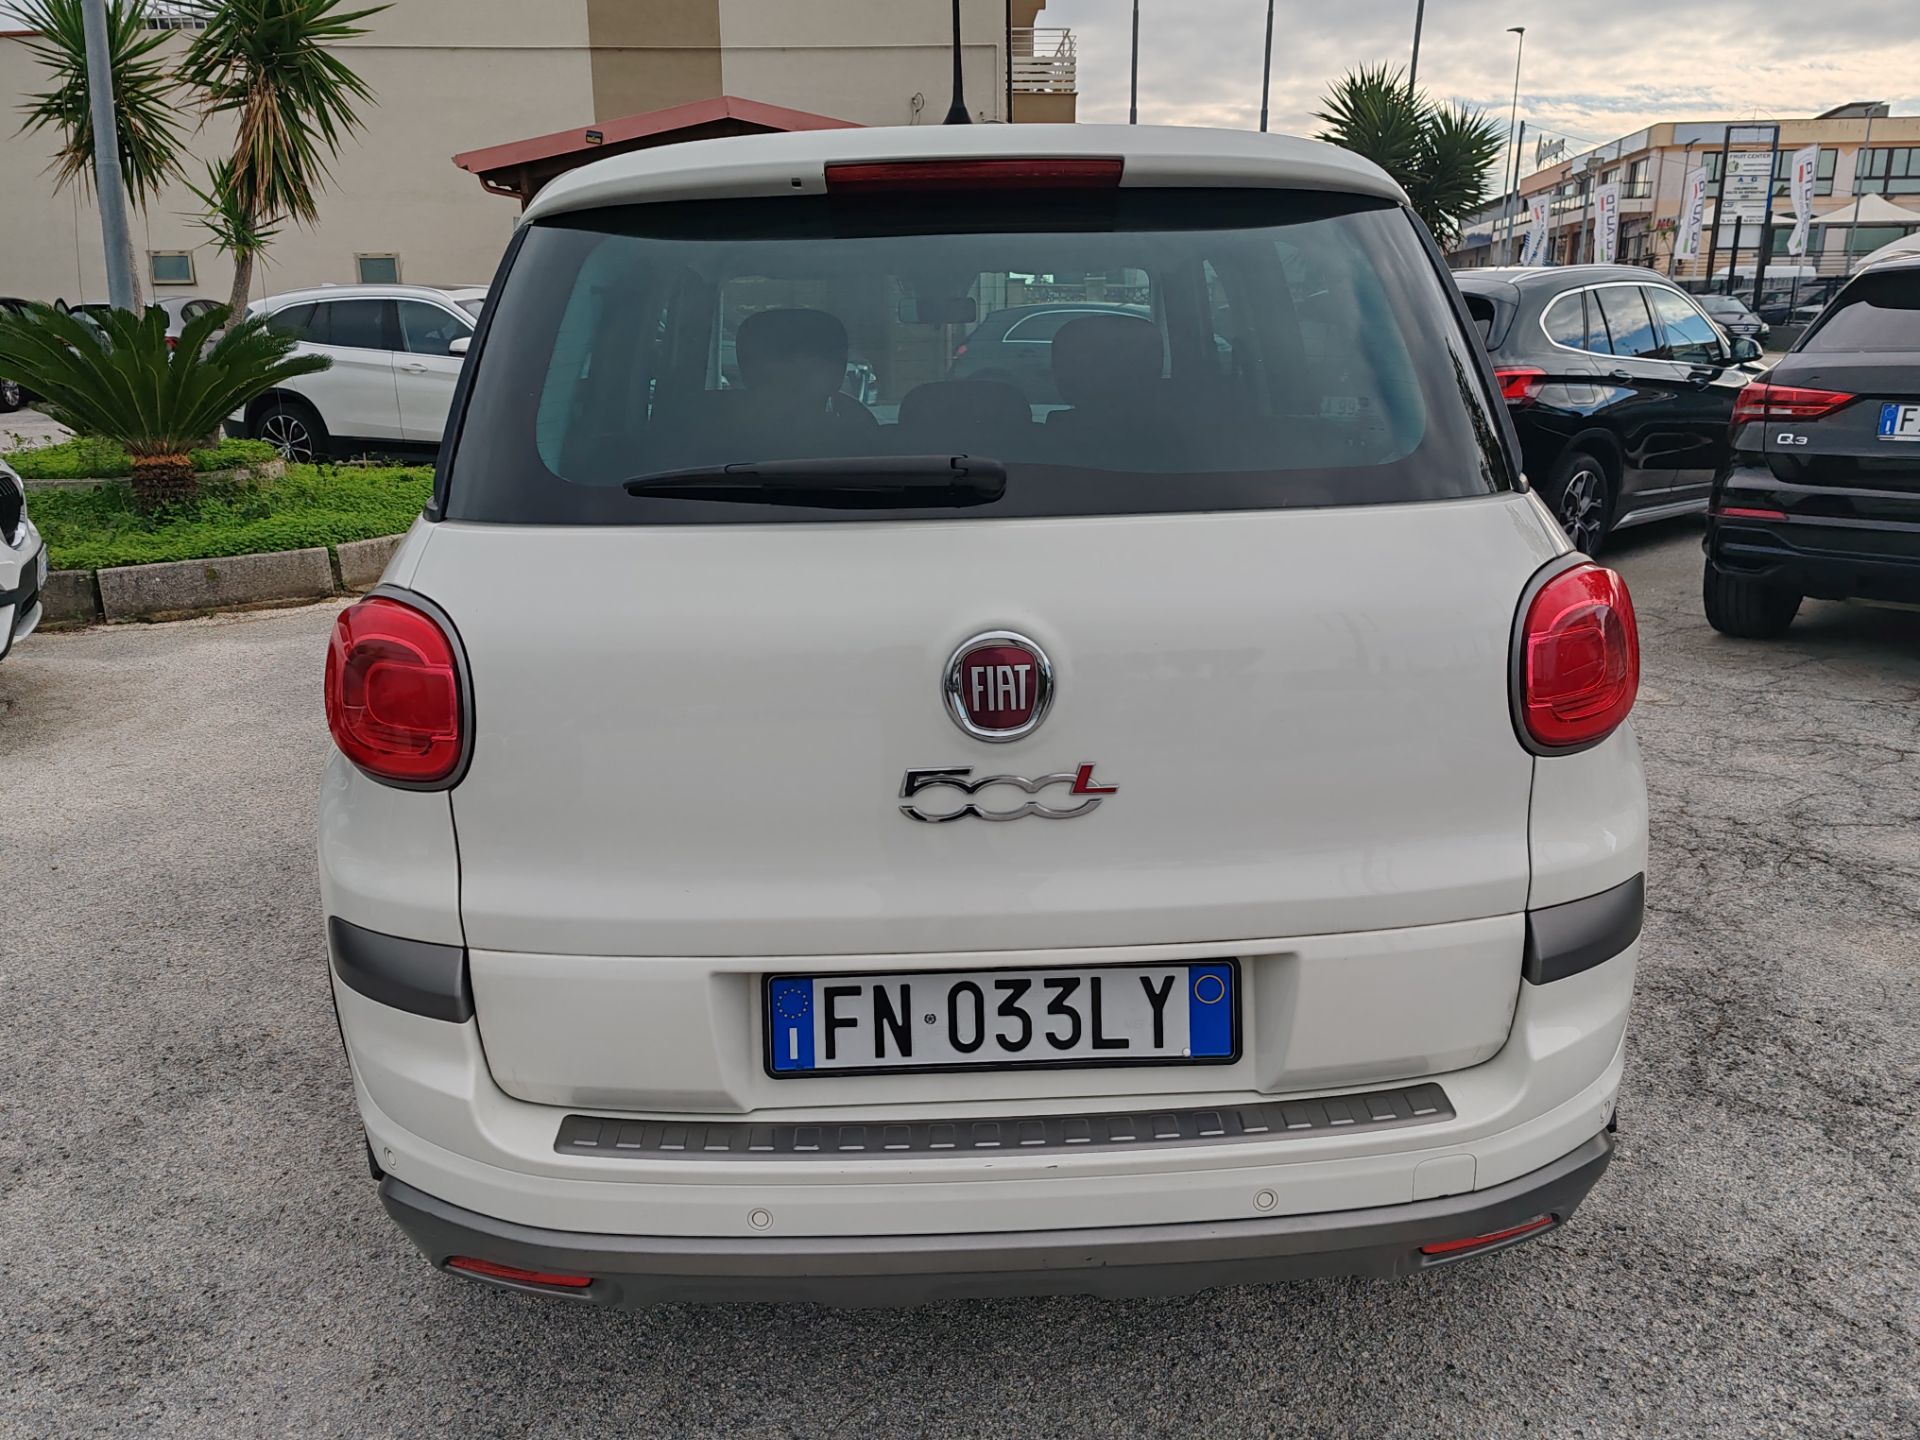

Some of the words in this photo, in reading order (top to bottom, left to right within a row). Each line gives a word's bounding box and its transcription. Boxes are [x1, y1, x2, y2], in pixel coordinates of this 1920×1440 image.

[1776, 433, 1808, 445] Q3
[970, 664, 1031, 711] FIAT
[899, 761, 1119, 823] 500L
[789, 1027, 798, 1060] I
